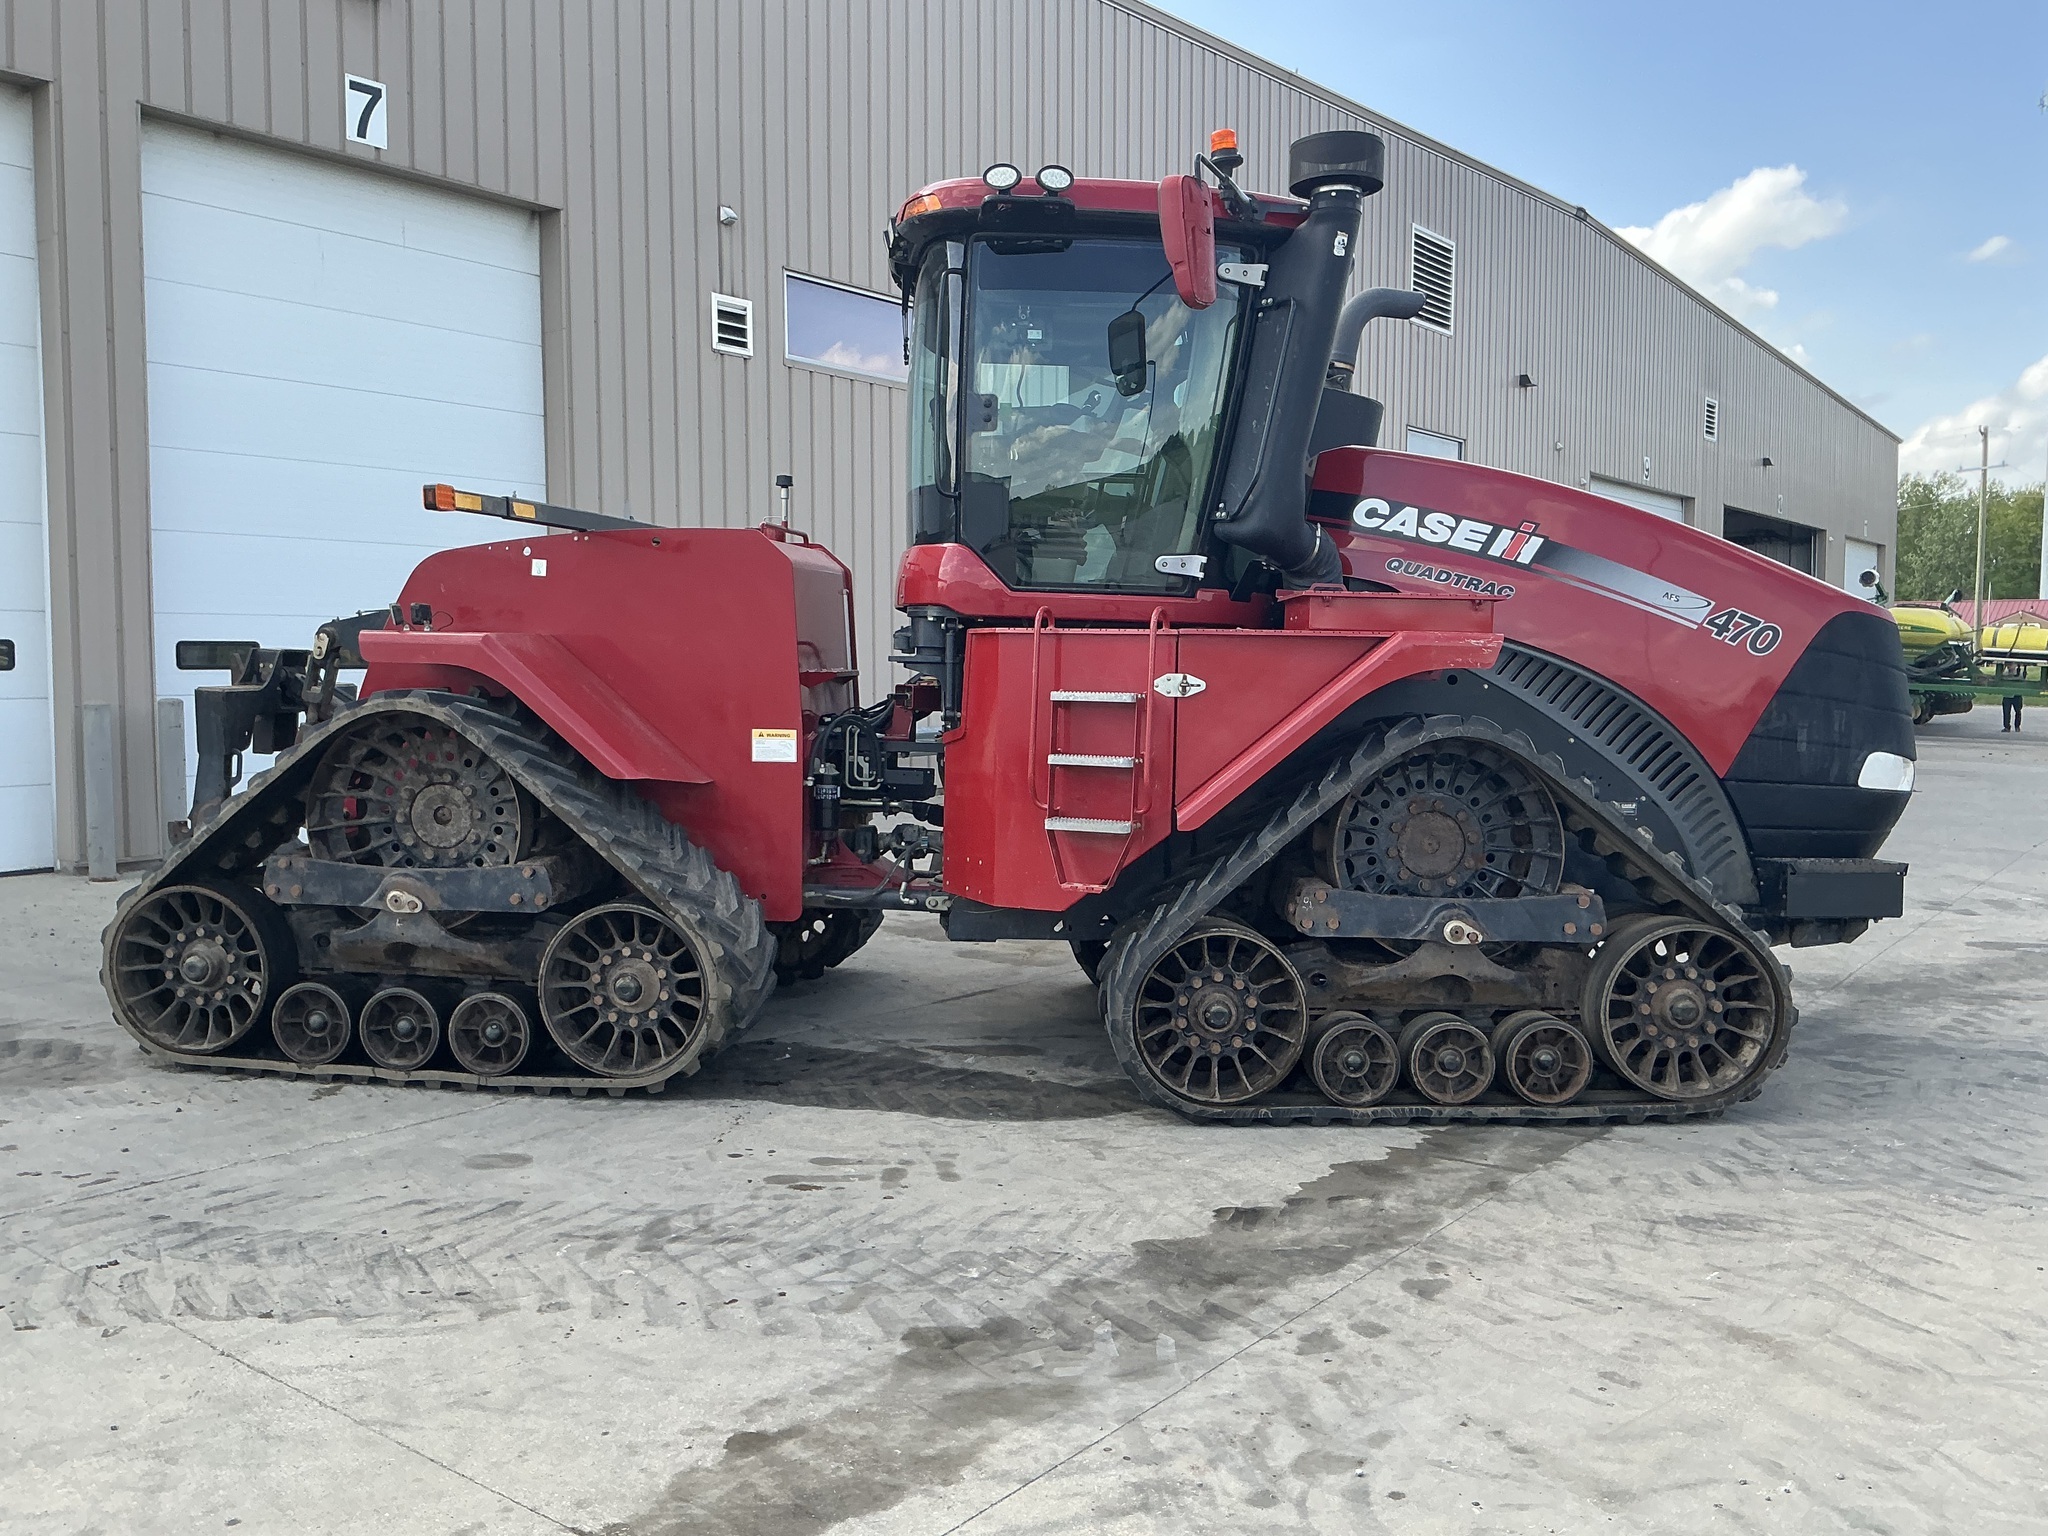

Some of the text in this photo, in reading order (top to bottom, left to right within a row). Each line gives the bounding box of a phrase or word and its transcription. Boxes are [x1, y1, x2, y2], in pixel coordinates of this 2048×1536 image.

[349, 79, 382, 139] 7
[1644, 458, 1650, 479] 9
[1353, 498, 1493, 551] CASE
[1385, 557, 1515, 599] QUADTRAC
[1662, 592, 1680, 603] AFS
[1702, 607, 1783, 656] 470
